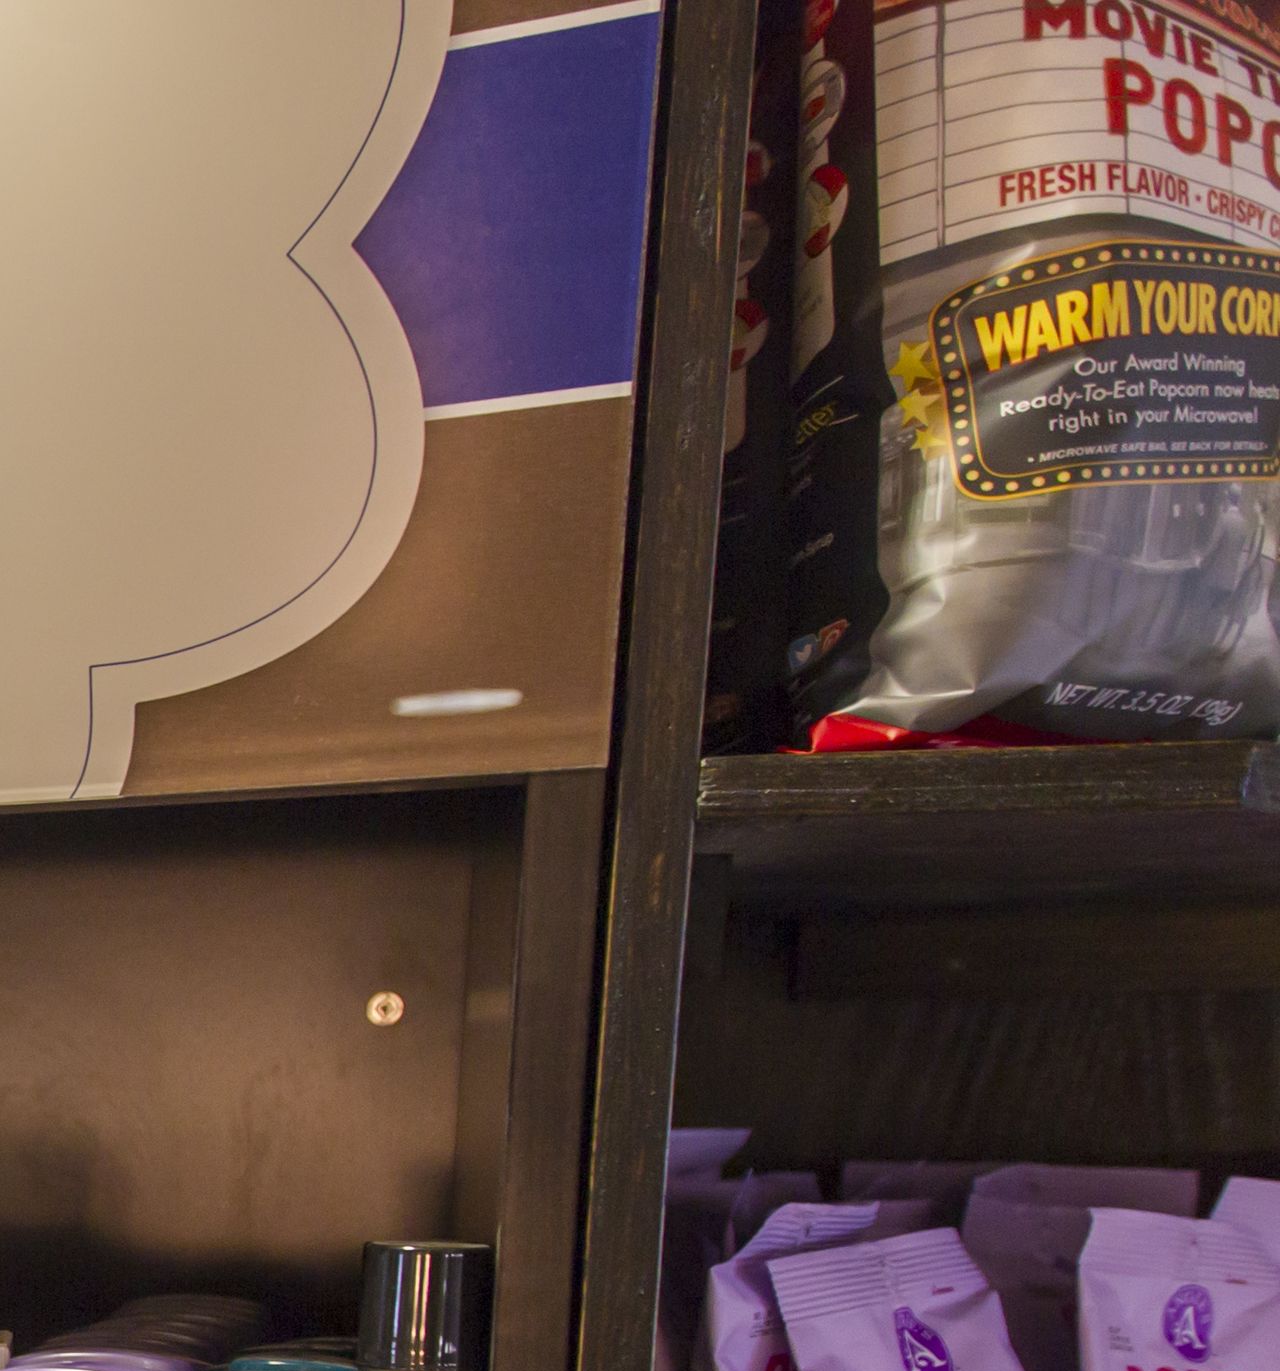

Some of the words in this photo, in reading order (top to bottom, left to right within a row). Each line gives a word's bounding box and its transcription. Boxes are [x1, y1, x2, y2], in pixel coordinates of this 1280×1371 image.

[998, 163, 1097, 208] FRESH
[1107, 164, 1190, 207] FLAVOR
[1206, 190, 1266, 235] CRISPY
[974, 280, 1132, 372] WARM
[1133, 279, 1217, 336] YOUR
[1074, 357, 1118, 377] Our
[1125, 353, 1178, 373] Award
[1183, 353, 1246, 376] Winning
[1000, 381, 1145, 418] Ready-To-Eat
[1149, 373, 1210, 401] Popcorn
[1213, 384, 1246, 398] now
[1048, 407, 1100, 435] right
[1108, 408, 1128, 427] in
[1135, 408, 1170, 428] your
[1173, 405, 1259, 424] Microwave!
[1039, 443, 1118, 463] MICROWAVE
[1045, 681, 1096, 706] NET
